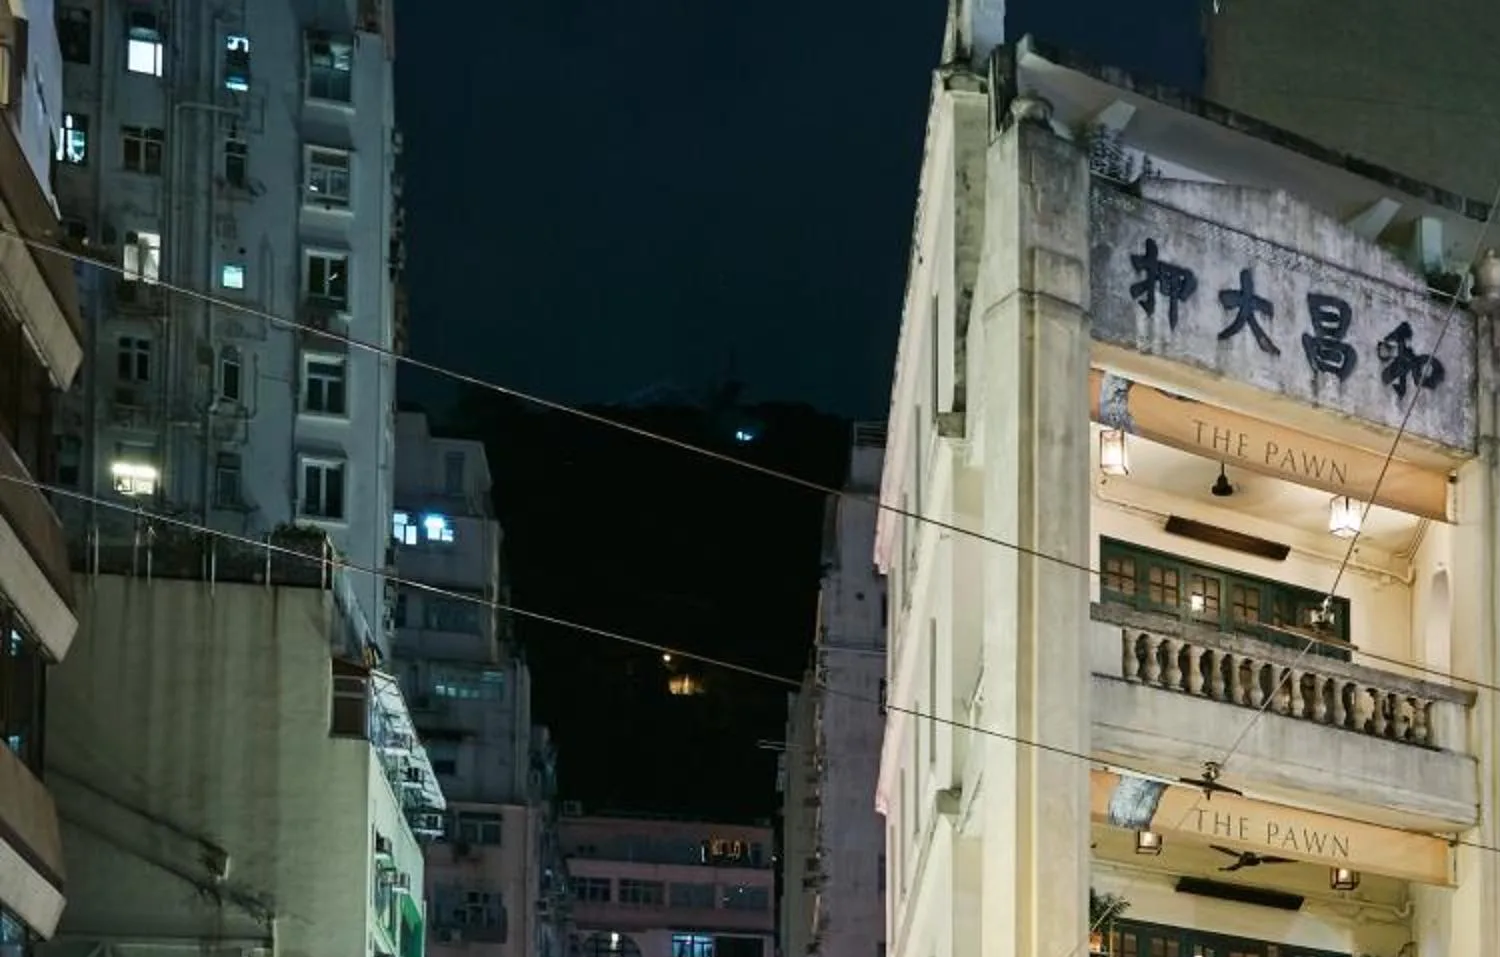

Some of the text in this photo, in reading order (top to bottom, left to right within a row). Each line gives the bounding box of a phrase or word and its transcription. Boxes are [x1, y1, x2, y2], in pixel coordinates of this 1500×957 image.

[1130, 238, 1445, 399] 和昌大押
[1193, 418, 1347, 485] THE PAWN
[1193, 807, 1350, 858] THE PAWN
